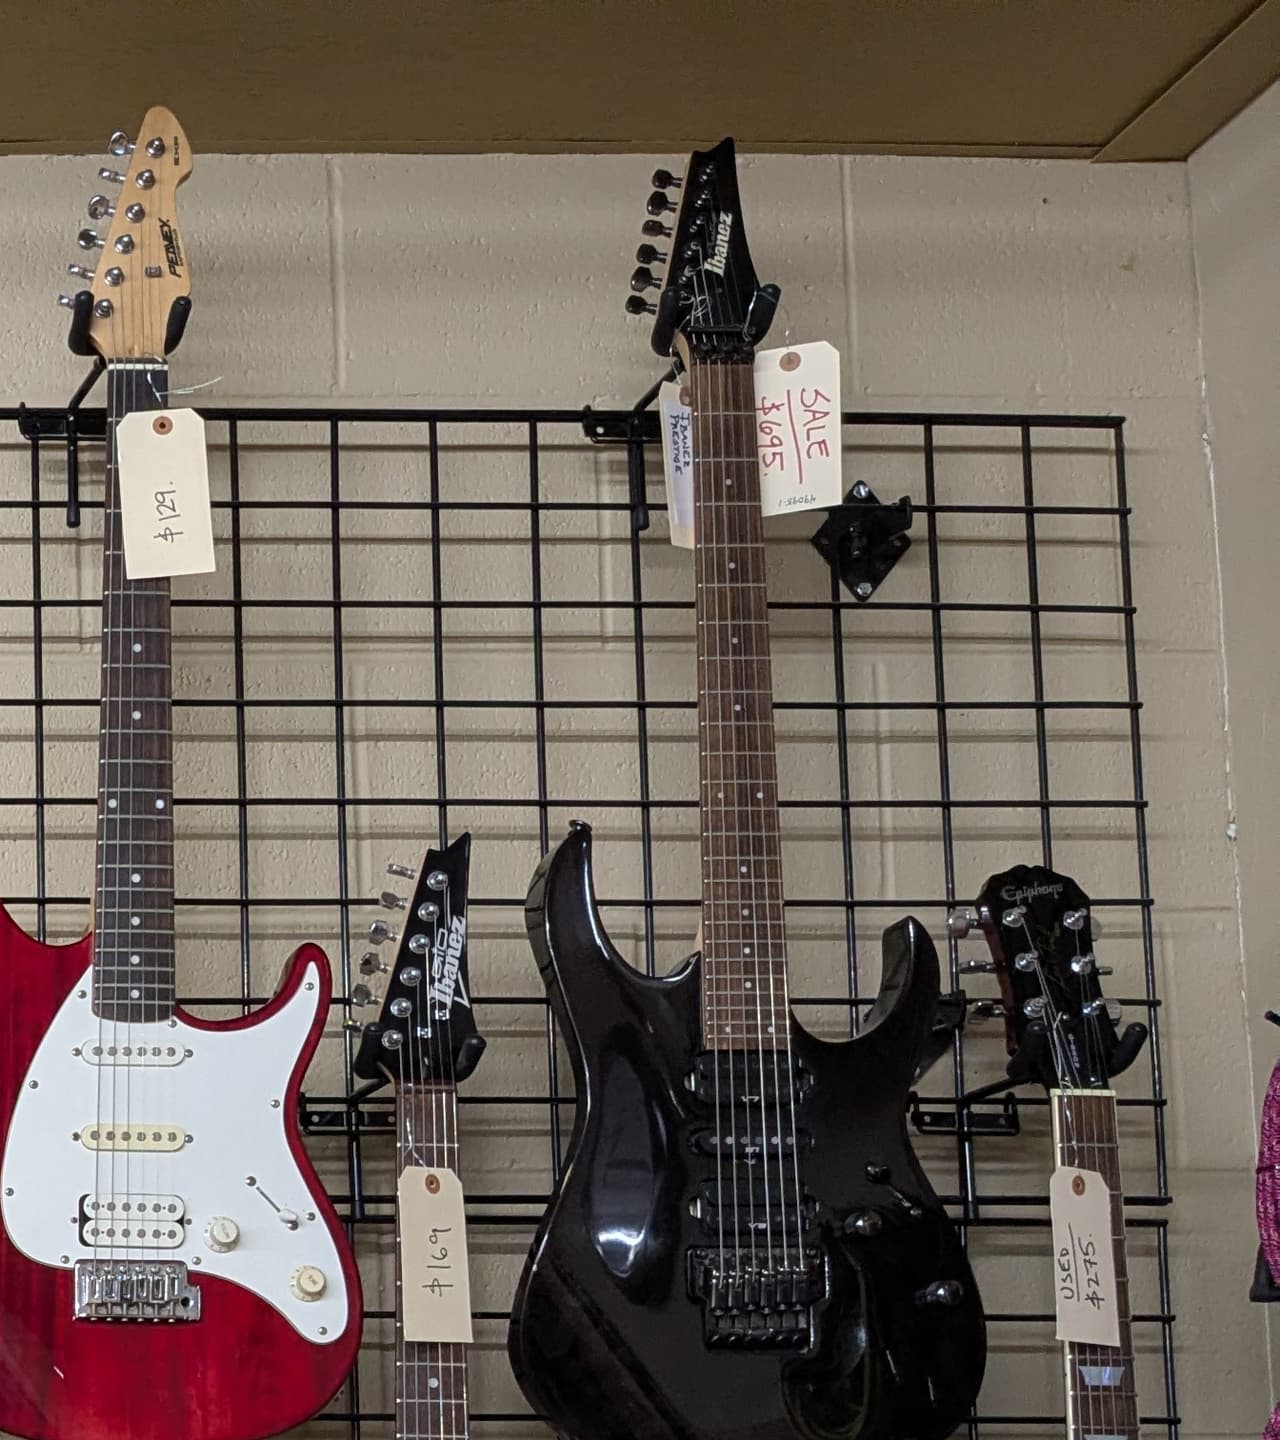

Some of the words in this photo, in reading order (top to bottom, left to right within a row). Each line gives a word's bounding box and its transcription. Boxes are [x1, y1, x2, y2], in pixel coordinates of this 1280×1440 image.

[703, 210, 733, 279] Ibanez
[801, 388, 830, 460] SALE
[1001, 882, 1064, 906] Epiphone
[431, 914, 466, 1014] Ibanez
[422, 1225, 452, 1297] $169
[1059, 1247, 1073, 1301] USED
